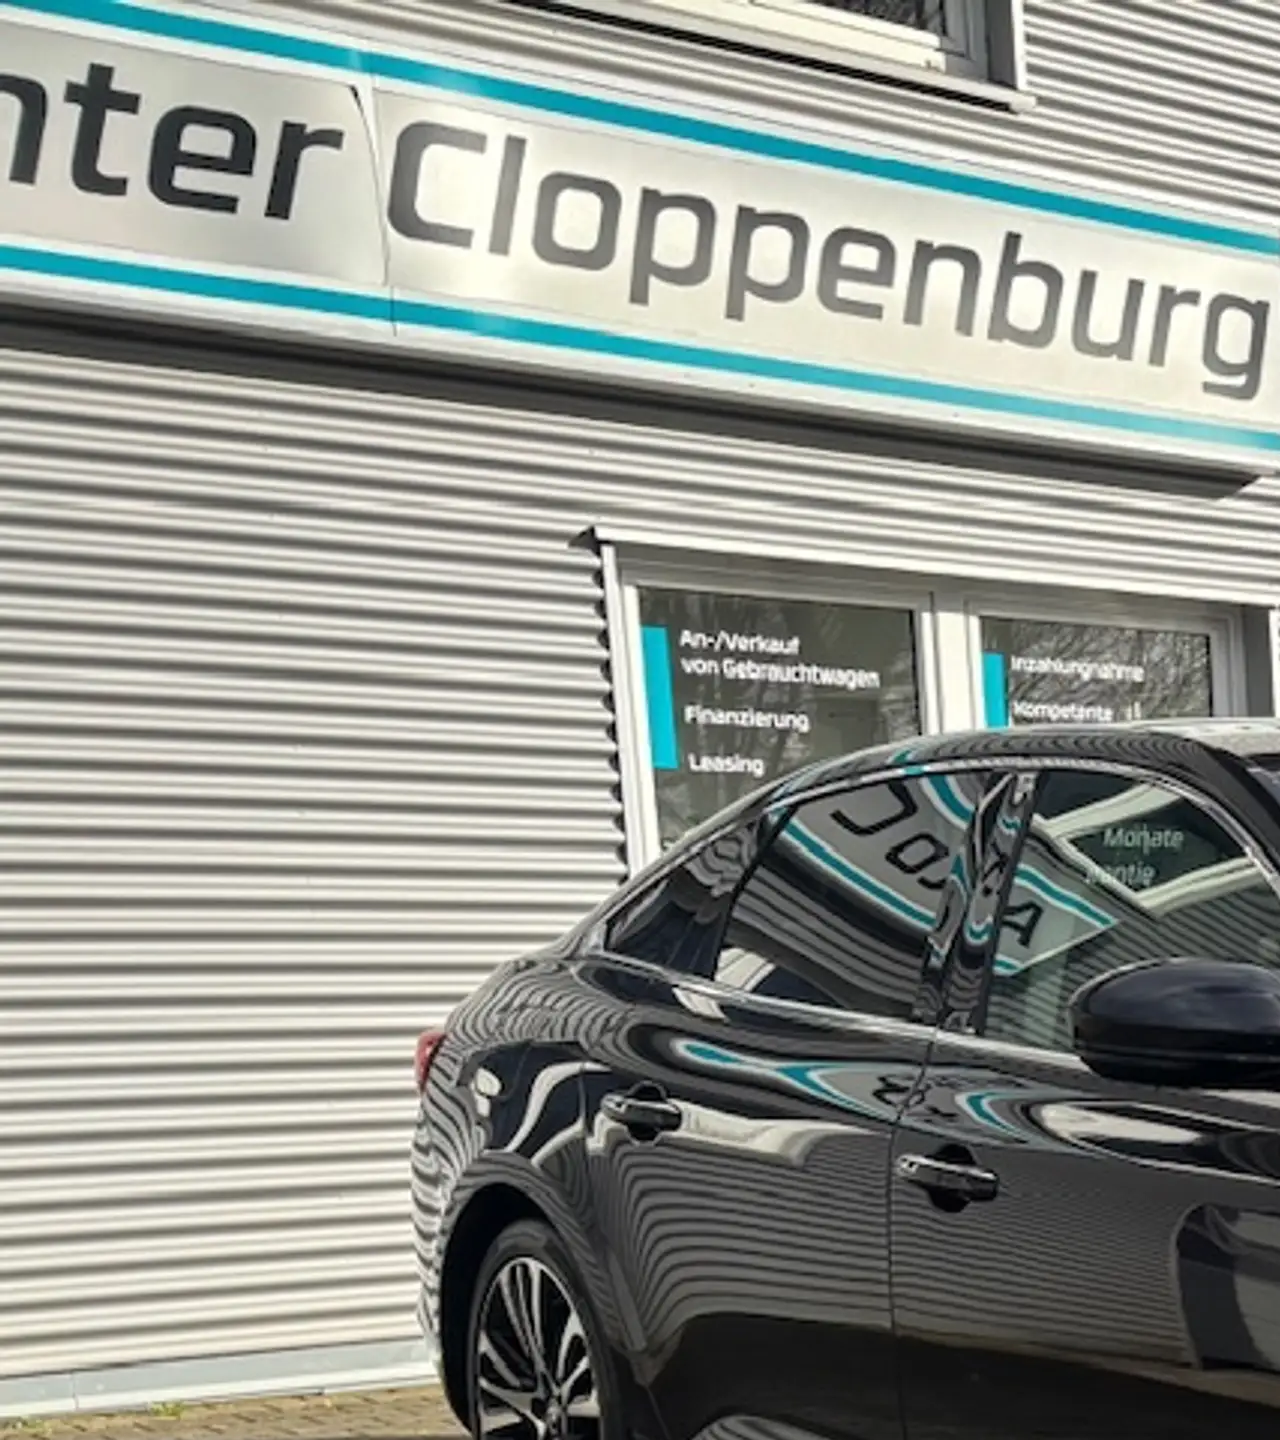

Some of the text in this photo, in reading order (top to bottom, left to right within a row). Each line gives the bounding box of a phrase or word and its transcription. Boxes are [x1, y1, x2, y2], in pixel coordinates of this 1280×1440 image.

[387, 119, 1270, 400] Cloppenburg
[680, 630, 799, 654] An-/Verkauf
[680, 658, 880, 690] von Gebrauchtwagen
[684, 705, 810, 732] Finanzierung
[688, 753, 764, 777] Leasing
[1103, 827, 1184, 850] Monate
